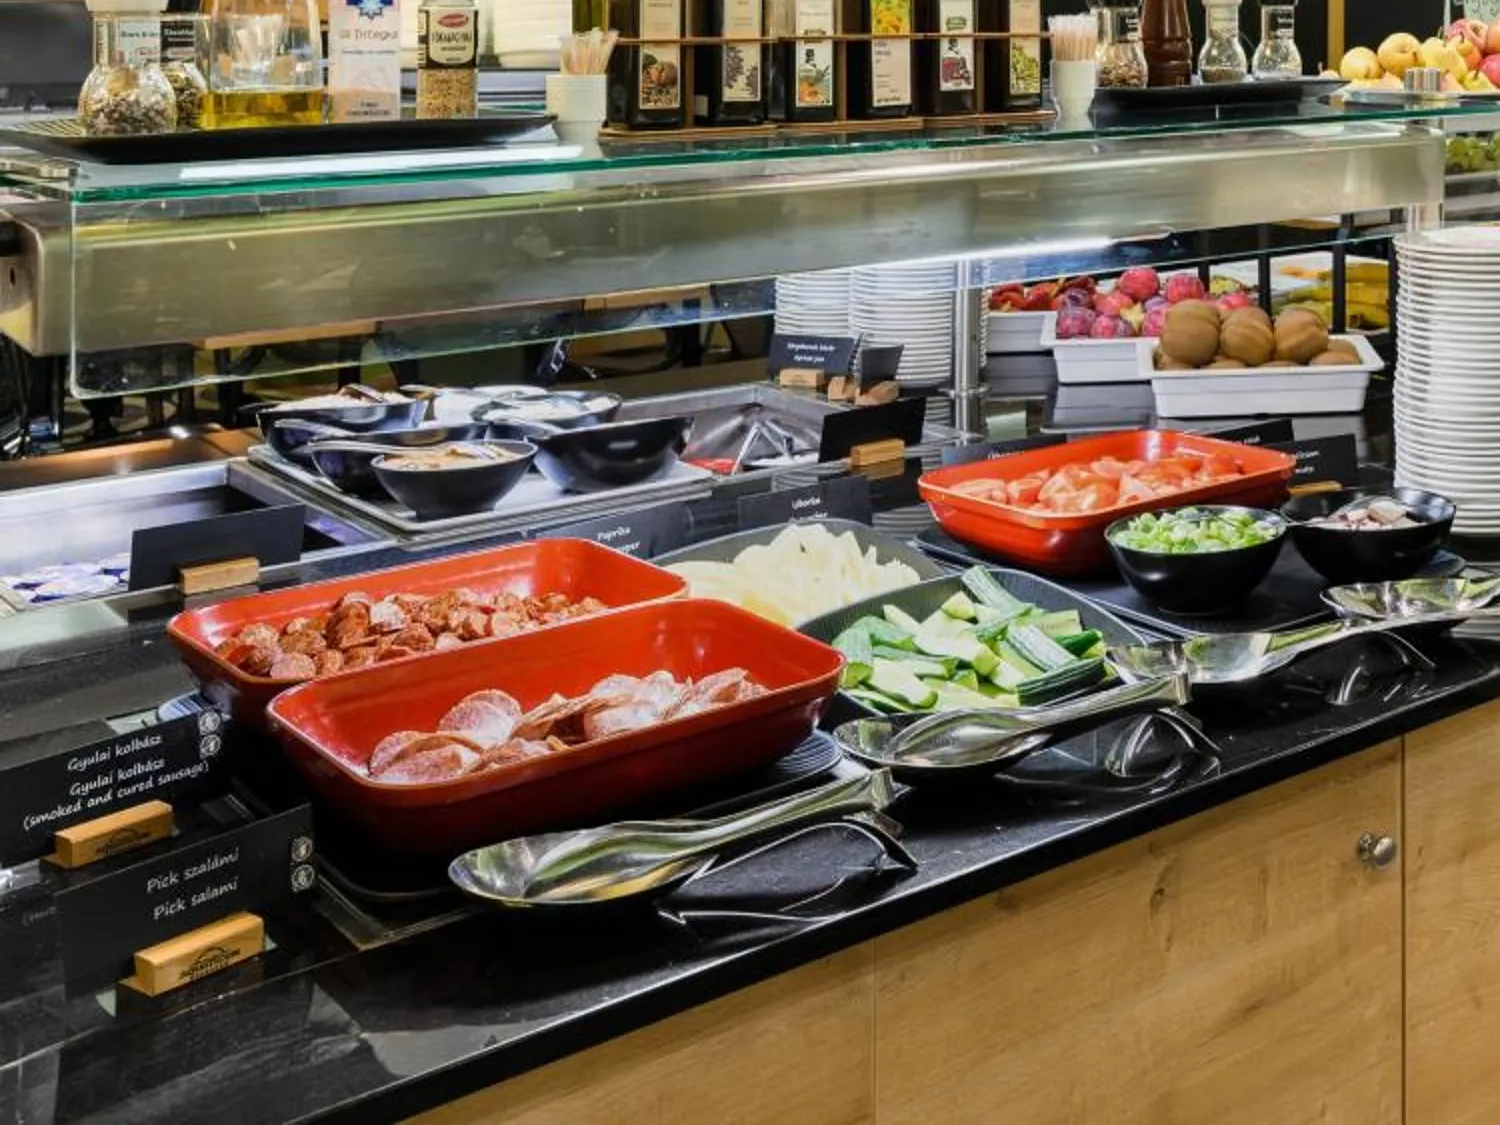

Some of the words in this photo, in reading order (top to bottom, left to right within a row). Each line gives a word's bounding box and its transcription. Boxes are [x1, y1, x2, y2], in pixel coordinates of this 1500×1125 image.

[67, 748, 111, 771] Gyulai
[115, 735, 163, 757] kolbász
[23, 800, 81, 830] (smoked
[87, 789, 112, 807] and
[117, 777, 153, 797] cured
[158, 761, 209, 785] sausage)
[69, 772, 114, 796] Gyulai
[118, 758, 165, 780] kolbász
[147, 871, 179, 893] Pick
[184, 847, 240, 880] szalámi
[153, 898, 186, 920] Pick
[191, 876, 239, 906] salami
